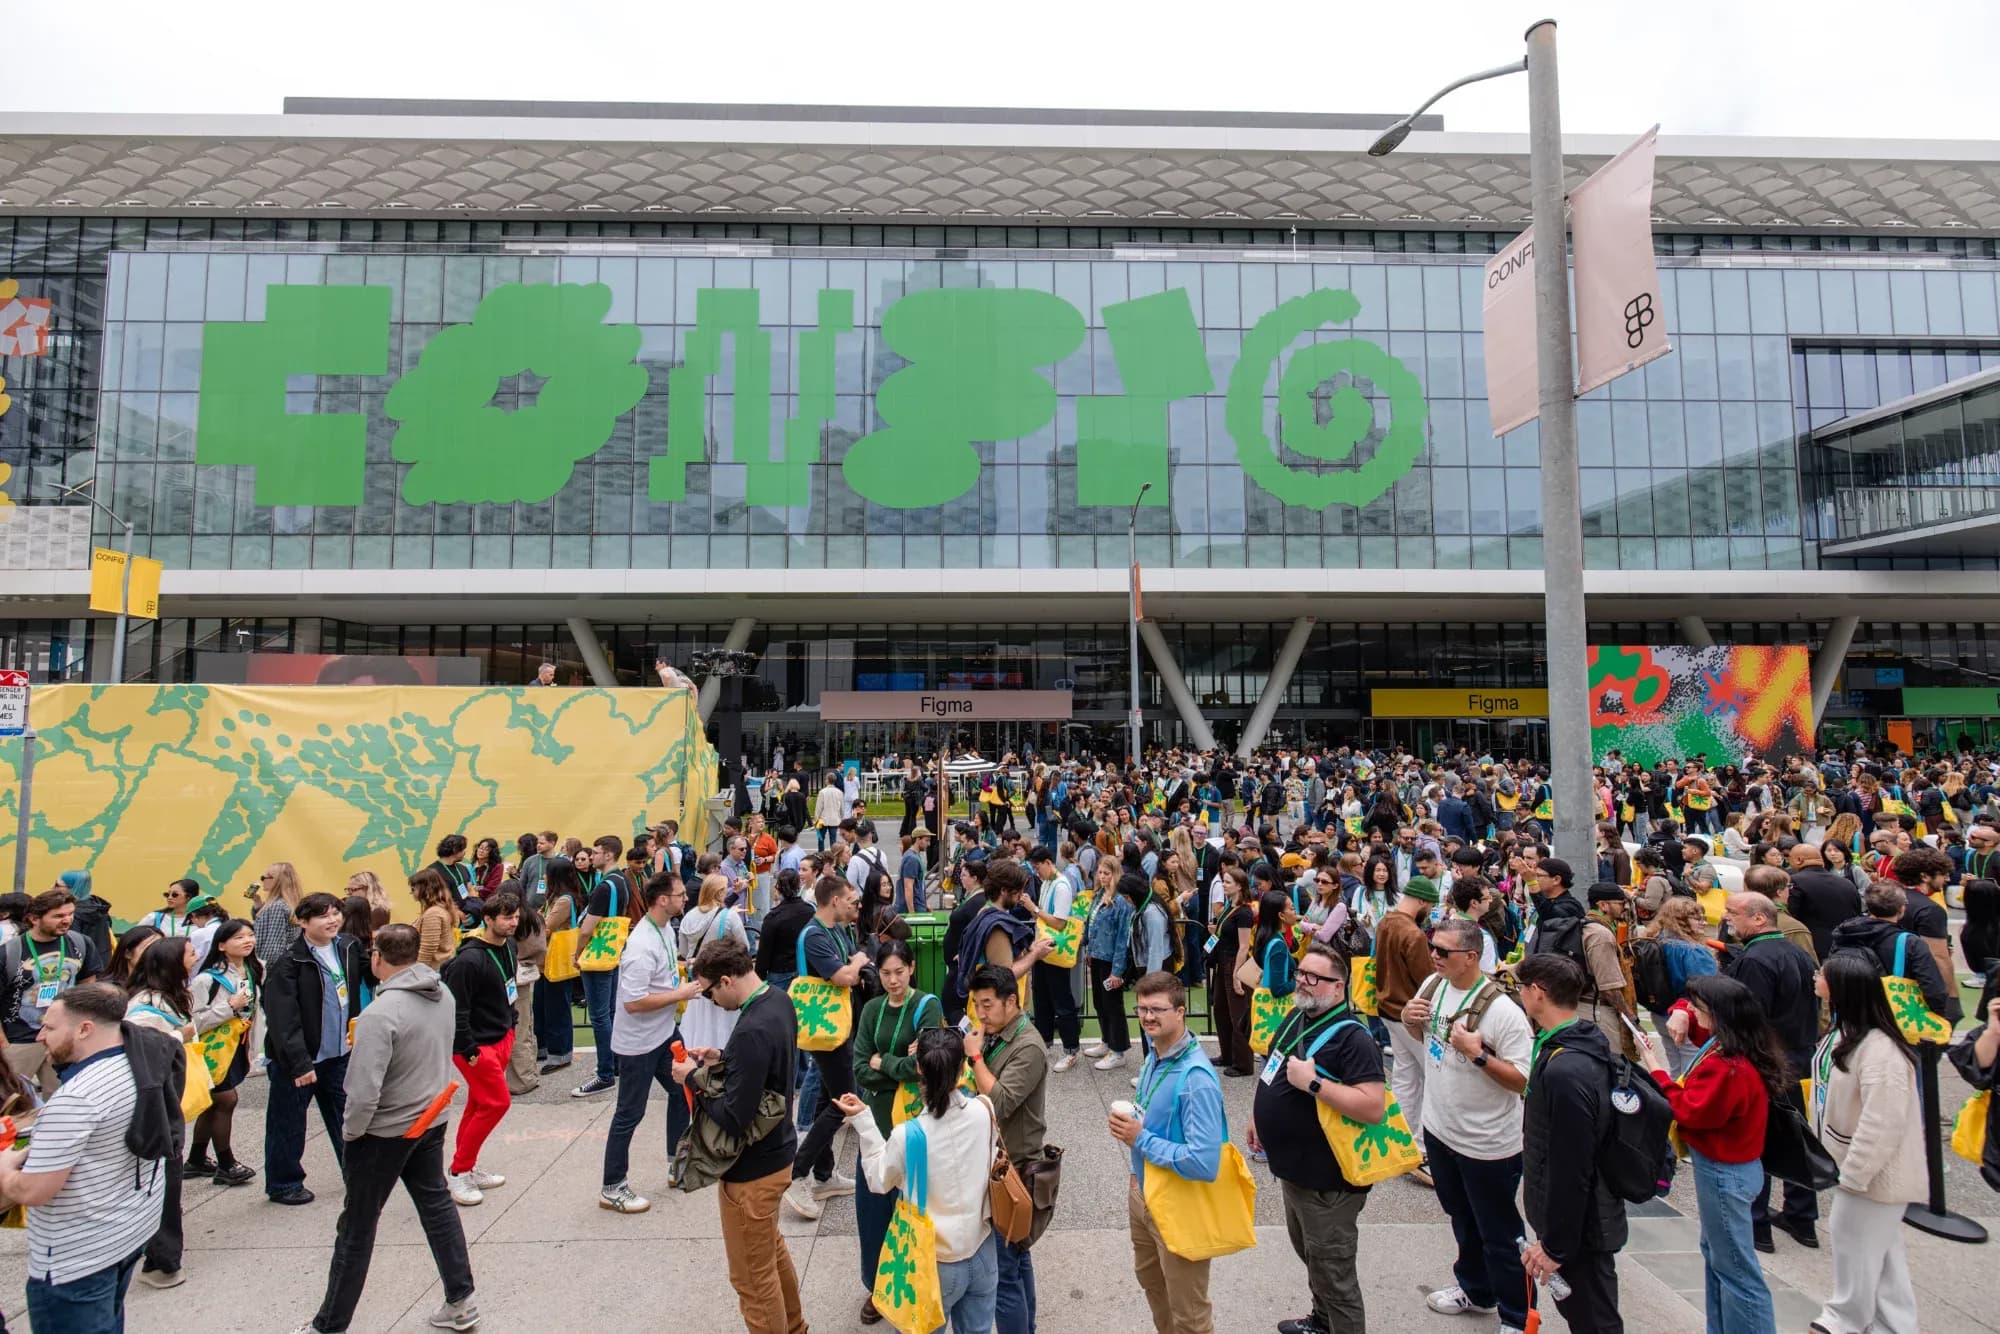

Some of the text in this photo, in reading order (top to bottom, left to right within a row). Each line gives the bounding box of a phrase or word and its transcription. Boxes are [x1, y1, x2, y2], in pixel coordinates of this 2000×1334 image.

[1488, 240, 1534, 289] CONFI
[95, 552, 125, 565] CONFIG
[2, 703, 17, 711] ALL
[920, 696, 974, 716] Figma
[1468, 694, 1520, 714] Figma
